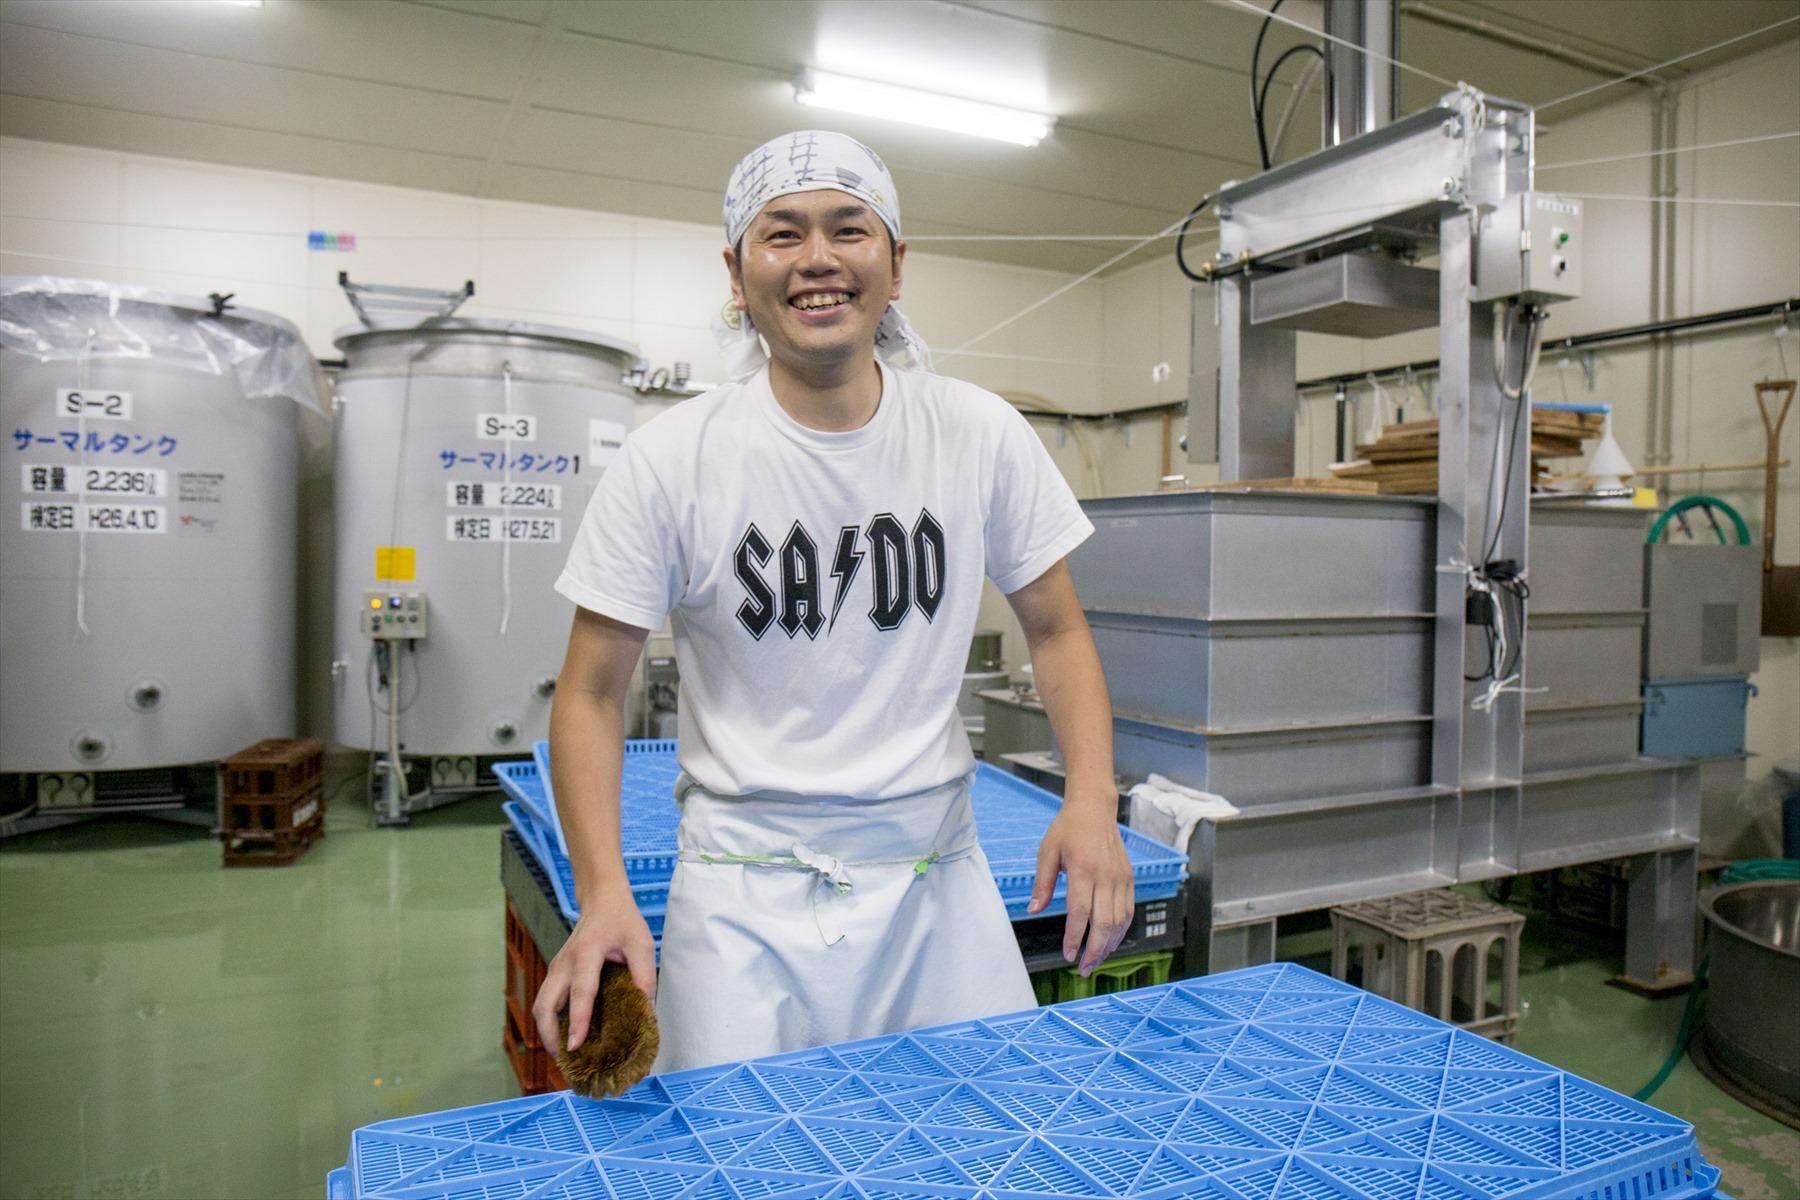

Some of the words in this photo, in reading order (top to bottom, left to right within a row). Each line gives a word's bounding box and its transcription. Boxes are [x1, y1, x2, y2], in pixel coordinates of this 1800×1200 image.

[66, 392, 123, 416] S-2
[485, 417, 530, 438] S-3
[12, 428, 178, 456] サーマルタンク
[30, 466, 68, 492] 容量
[455, 484, 485, 506] 容量
[30, 505, 75, 530] 検定日
